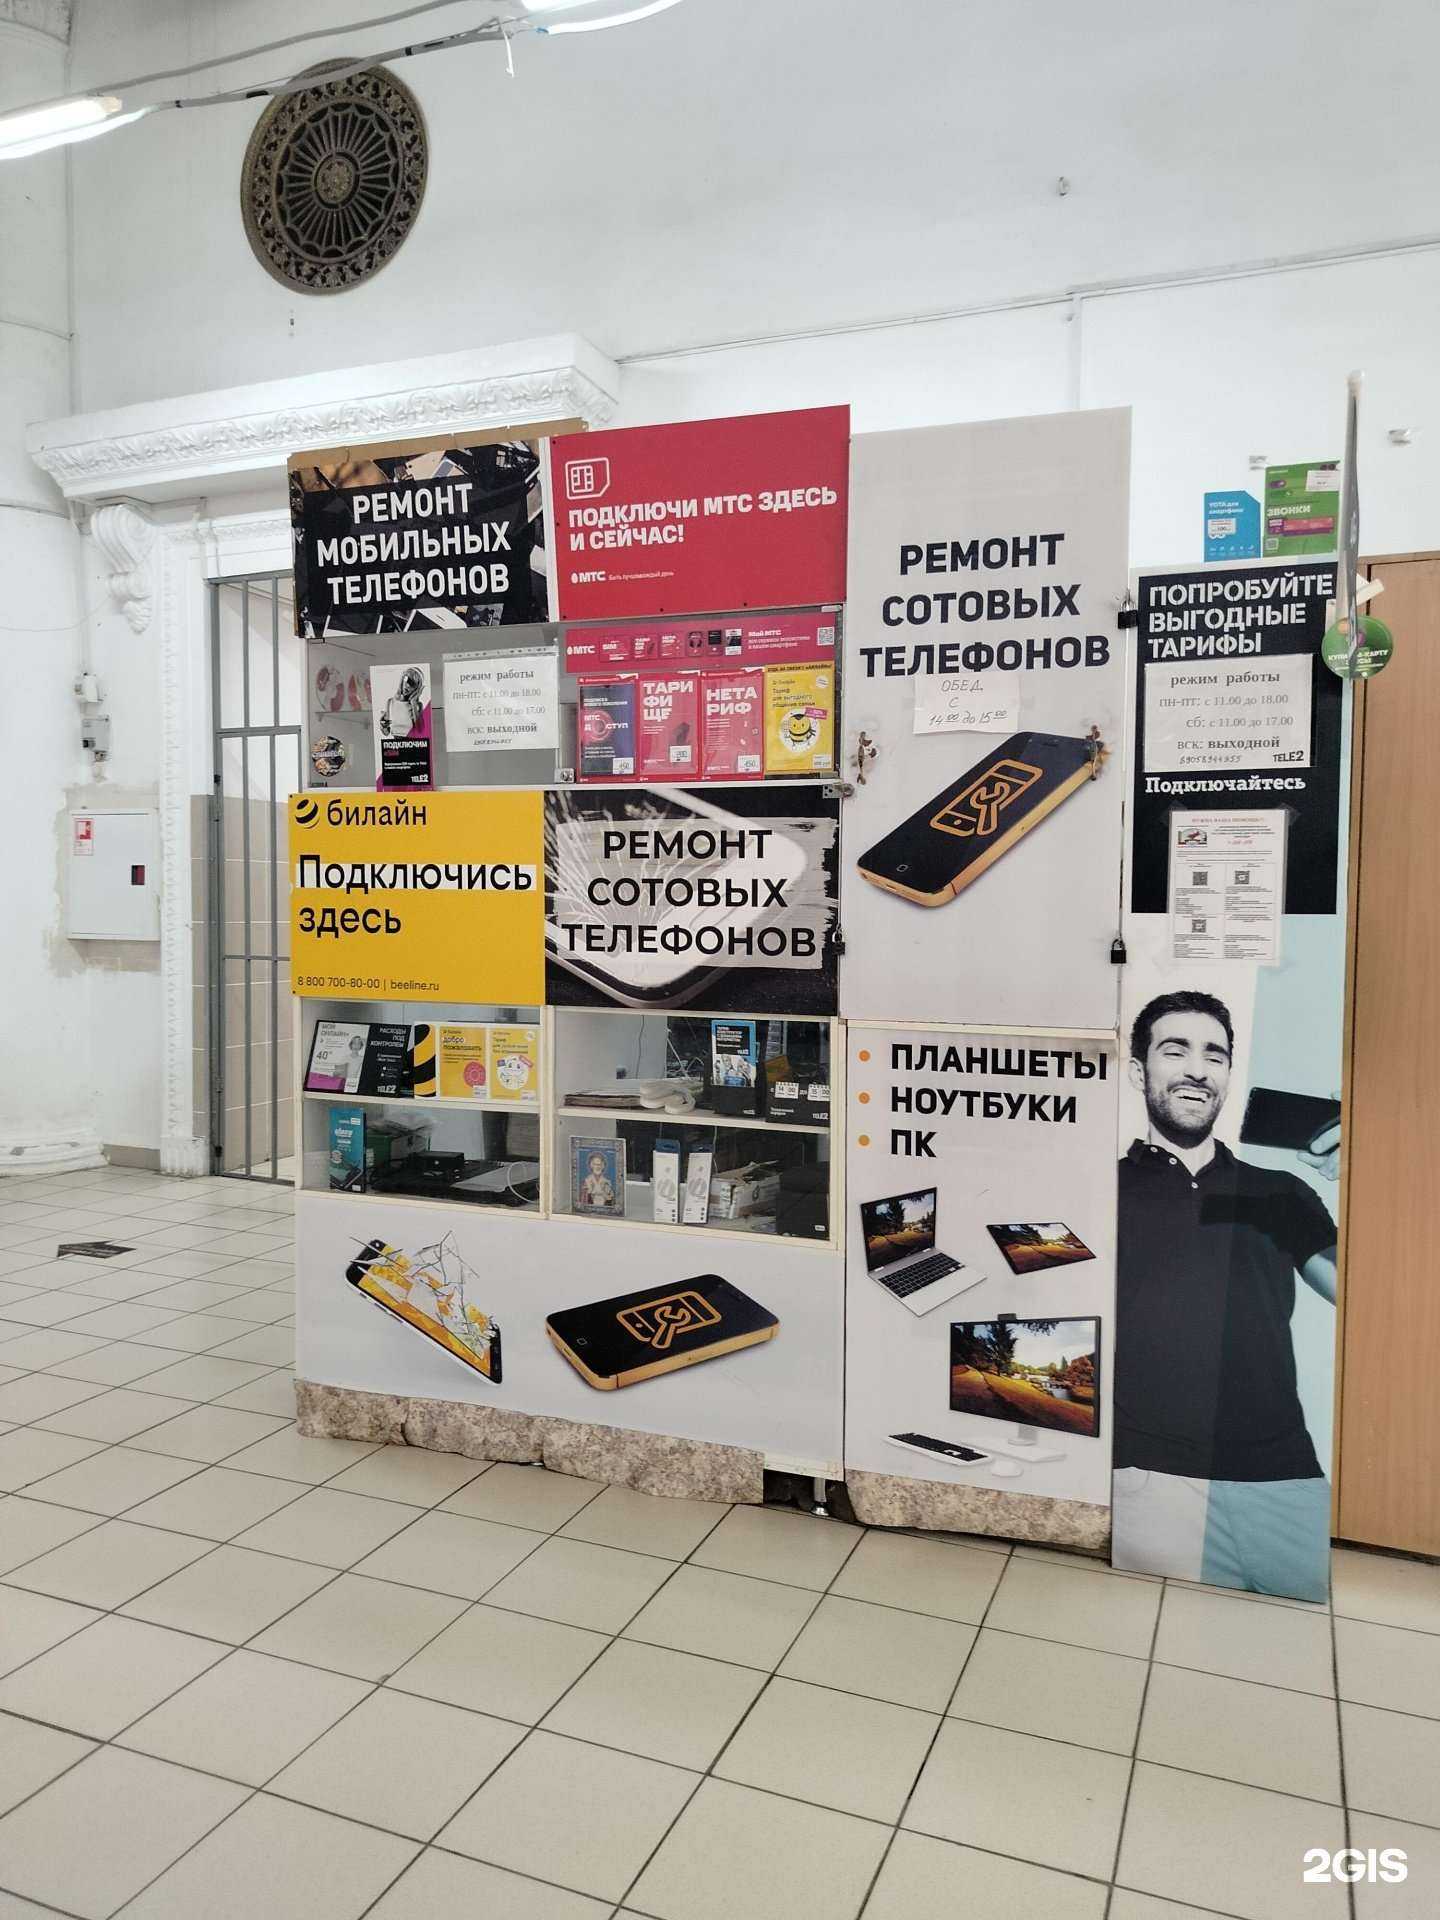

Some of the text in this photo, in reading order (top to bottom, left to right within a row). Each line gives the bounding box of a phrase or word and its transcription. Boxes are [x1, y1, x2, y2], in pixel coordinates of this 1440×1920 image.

[352, 483, 473, 524] РЕМОНТ
[569, 486, 838, 529] ПОДКЛЮЧИ МТС ЗДЕСЬ
[1266, 504, 1311, 517] ЗВОНКИ
[317, 521, 512, 567] МОБИЛЬНЫХ
[570, 524, 685, 551] И СЕЙЧАС!
[900, 533, 1065, 575] РЕМОНТ
[327, 563, 510, 605] ТЕЛЕФОНОВ
[579, 571, 606, 583] МТС
[1149, 572, 1333, 607] ПОПРОБУЙТЕ
[882, 584, 1081, 626] СОТОВЫХ
[1149, 603, 1306, 633] ВЫГОДНЫЕ
[573, 645, 596, 655] МТС
[860, 635, 1110, 677] ТЕЛЕФОНОВ
[1148, 632, 1262, 659] ТАРИФЫ
[460, 668, 535, 685] режим работы
[643, 681, 694, 694] ТАРИ
[1170, 670, 1280, 689] режим работы
[643, 695, 673, 707] ФИ
[706, 686, 758, 701] НЕТА
[1214, 696, 1242, 706] 11.00
[1243, 697, 1257, 706] до
[1261, 694, 1289, 704] 18.00
[643, 708, 673, 722] ЩЕ
[706, 702, 752, 716] РИФ
[1218, 717, 1246, 727] 11.00
[1248, 718, 1262, 728] до
[1266, 716, 1294, 726] 17.00
[487, 723, 537, 734] выходной
[1207, 736, 1280, 750] выходной
[1272, 750, 1305, 763] TELE2
[410, 774, 429, 783] TELE2
[1145, 774, 1307, 794] Подключайтесь
[327, 799, 427, 826] билайн
[603, 829, 773, 860] РЕМОНТ
[299, 855, 532, 895] Подключись
[587, 877, 788, 908] СОТОВЫХ
[299, 906, 401, 938] здесь
[561, 923, 817, 957] ТЕЛЕФОНОВ
[297, 976, 440, 991] 8 800 700-80-00 beeline.ru
[891, 1043, 1108, 1080] ПЛАНШЕТЫ
[891, 1086, 1077, 1124] НОУТБУКИ
[890, 1128, 937, 1158] ПК
